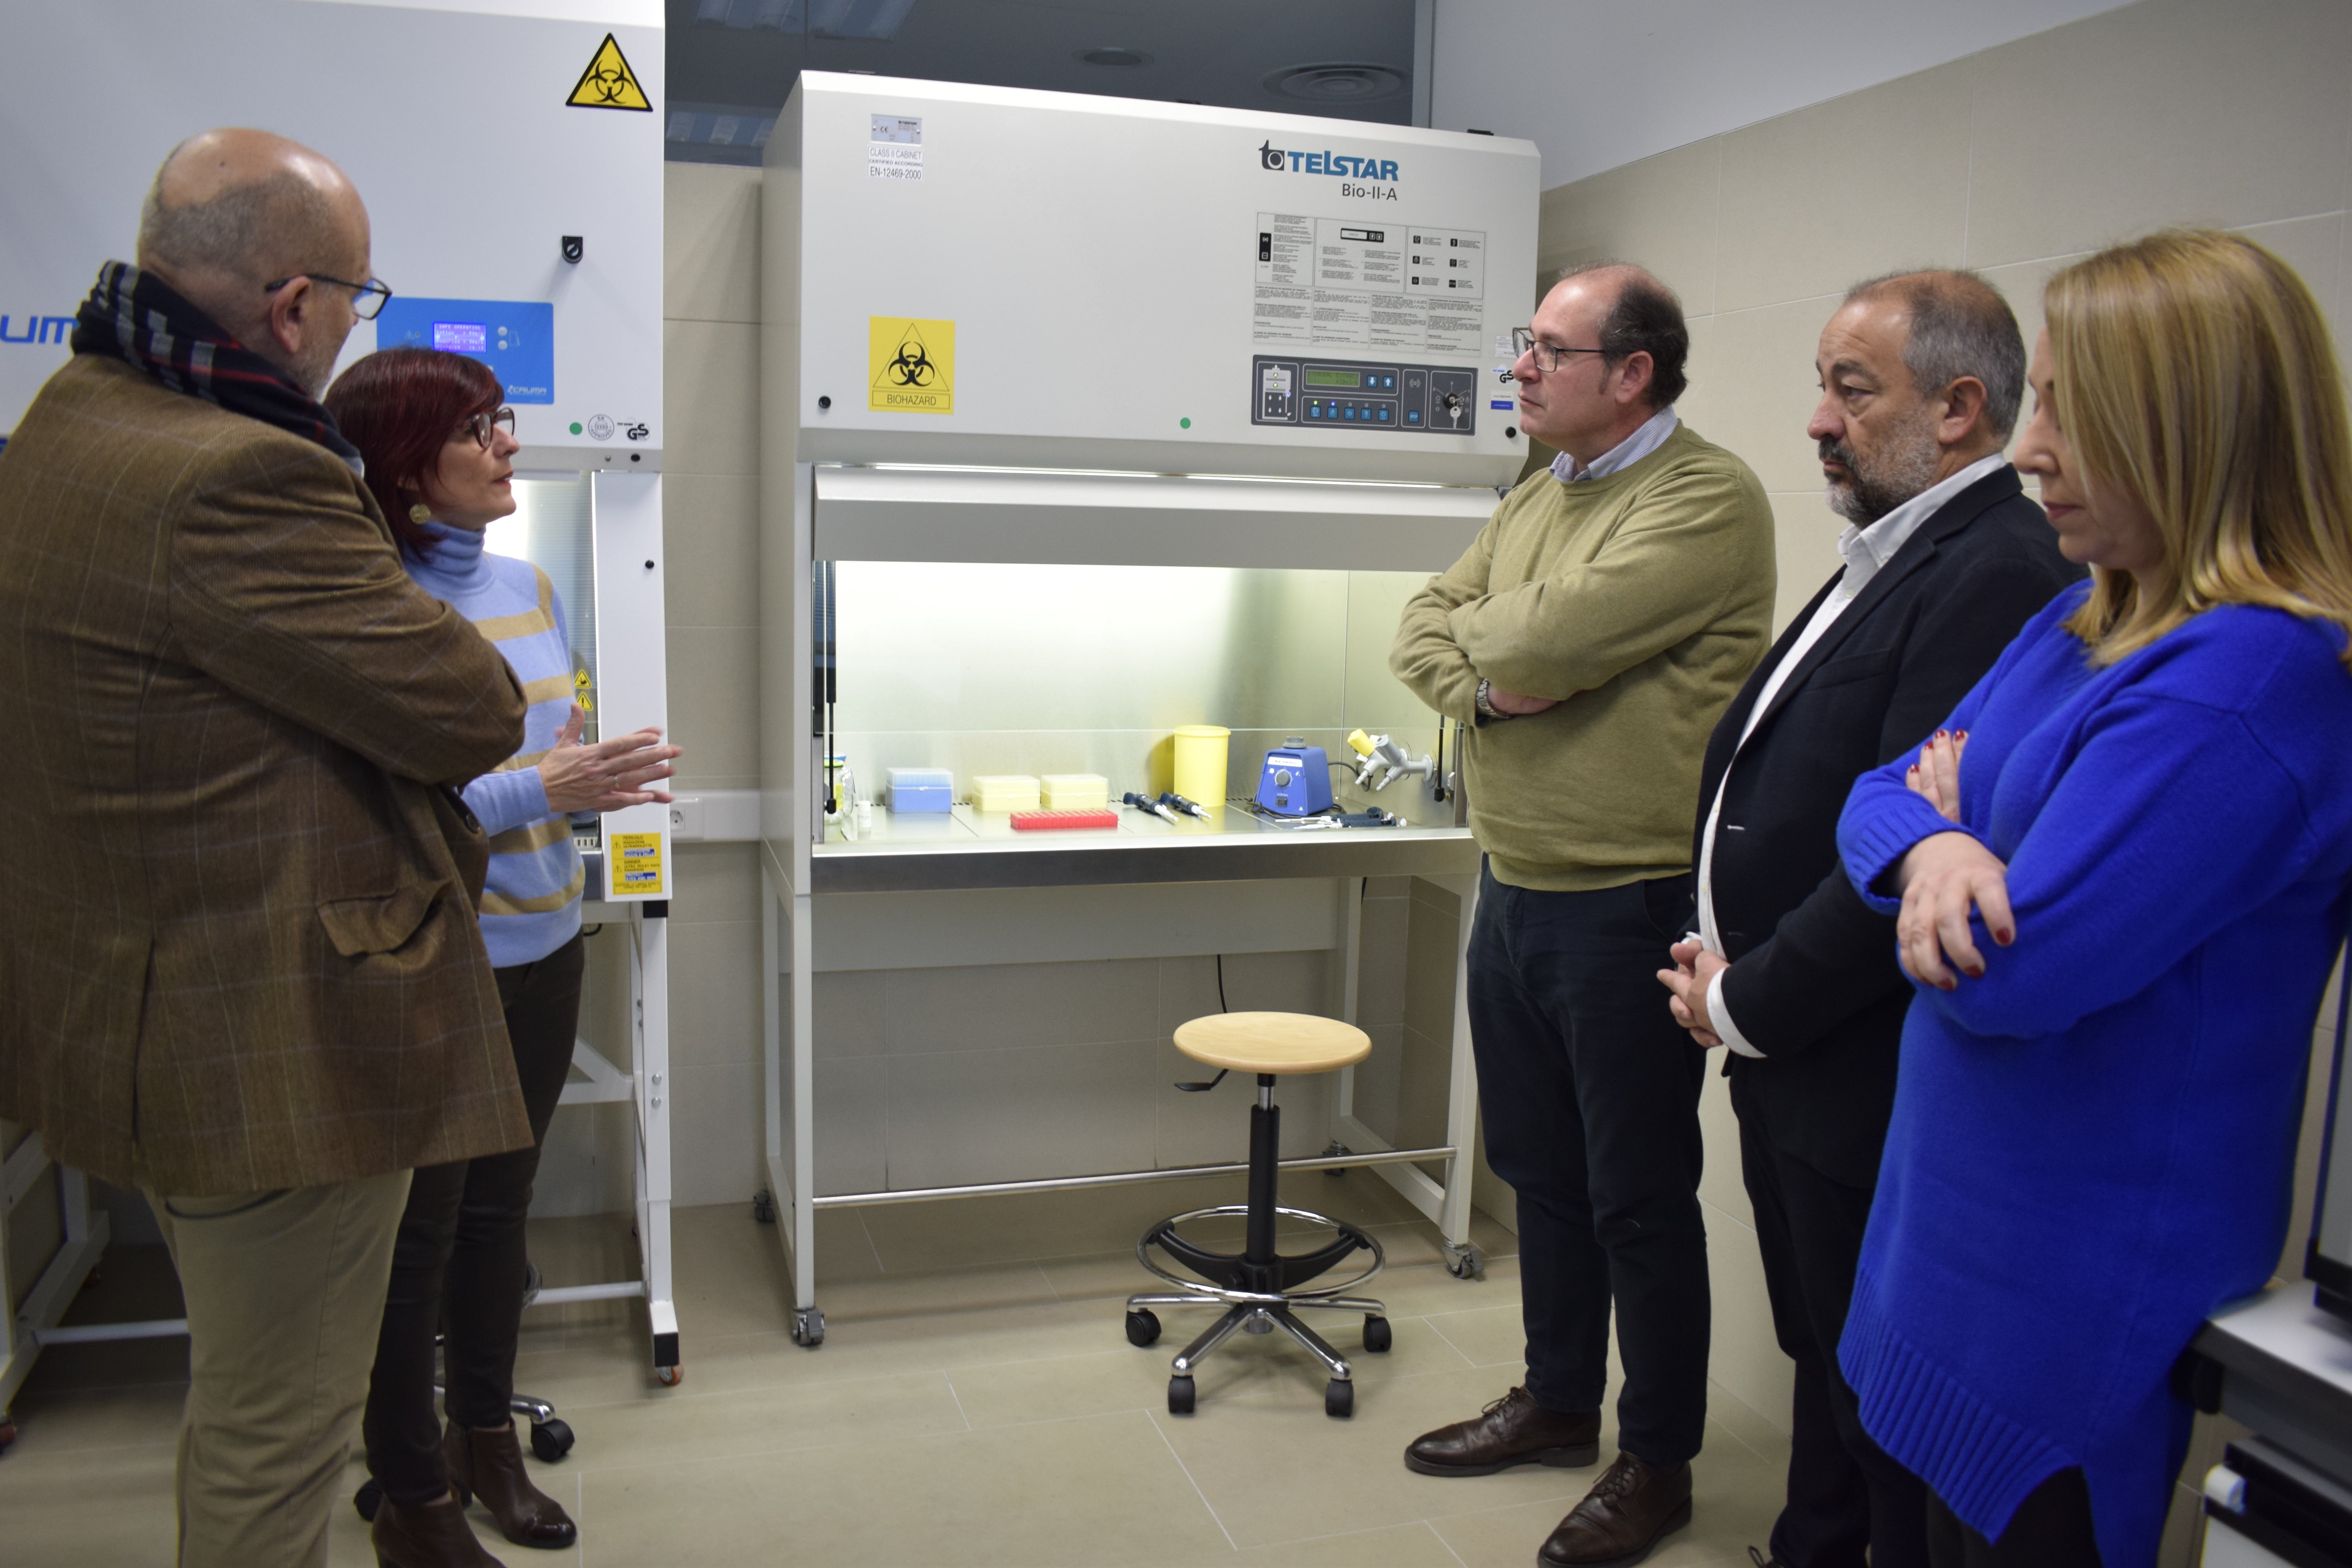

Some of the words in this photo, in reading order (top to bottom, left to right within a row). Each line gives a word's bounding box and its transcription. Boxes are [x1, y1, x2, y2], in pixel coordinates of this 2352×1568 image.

[870, 147, 889, 157] CLASS
[896, 150, 921, 160] CABINET
[870, 166, 921, 180] EN-12469-2000
[1287, 151, 1399, 181] TELSTAR
[1342, 183, 1397, 201] Bio-II-A
[887, 394, 936, 406] BIOHAZARD
[628, 424, 649, 440] GS
